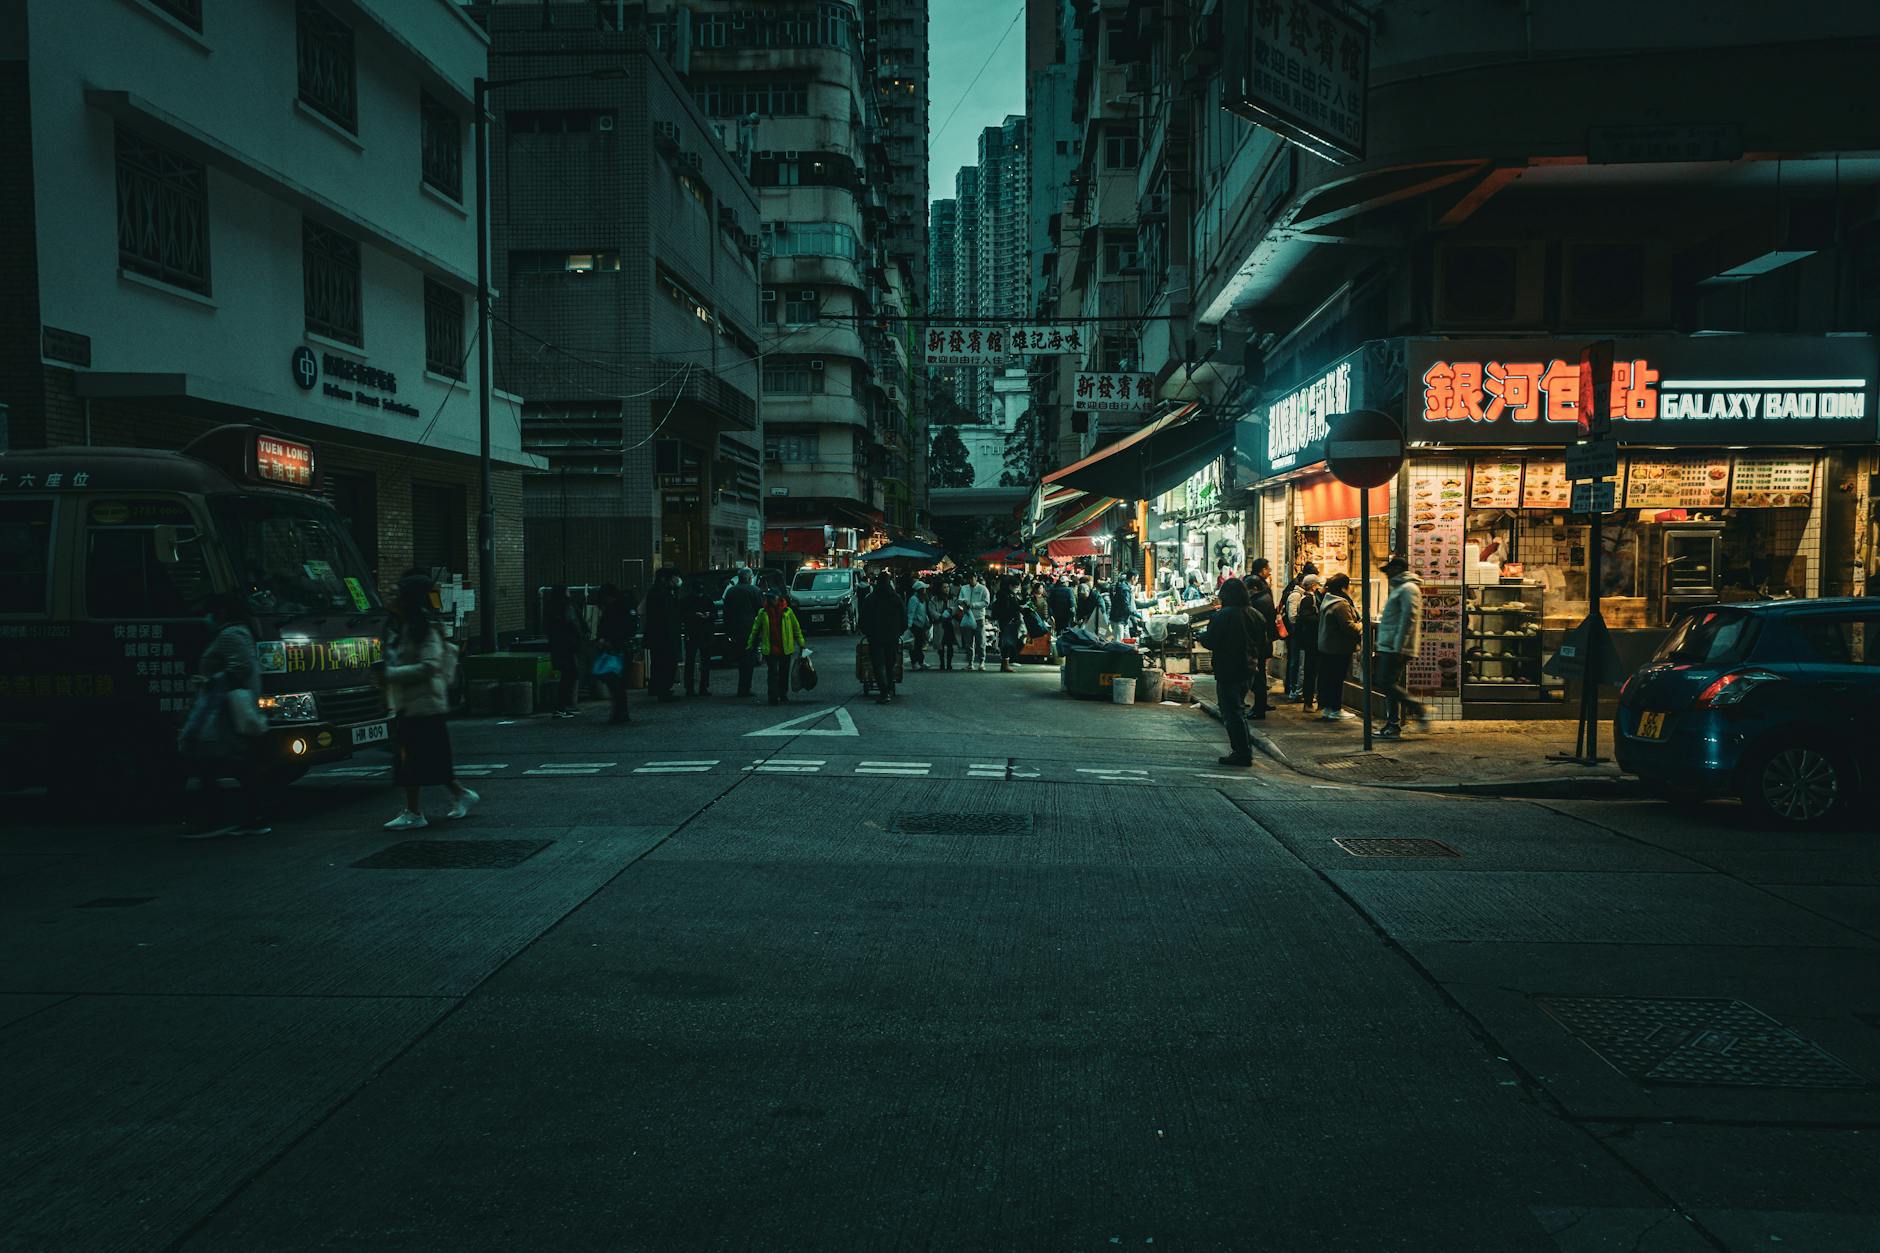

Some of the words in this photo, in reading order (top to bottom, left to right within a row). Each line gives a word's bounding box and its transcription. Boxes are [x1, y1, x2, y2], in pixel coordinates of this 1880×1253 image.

[1255, 37, 1361, 116] 歡迎自由行人住
[927, 329, 1002, 353] 新發賓館
[1011, 329, 1082, 350] 雄記海味
[927, 356, 1003, 365] 歡迎自由行人住
[1076, 375, 1153, 399] 新發賓館
[356, 391, 379, 407] Street
[1660, 393, 1761, 419] GALAXY
[1763, 393, 1816, 419] BAO
[1819, 393, 1865, 418] DIM
[259, 440, 283, 456] YUEN
[286, 446, 309, 462] LONG
[258, 458, 310, 485] 元朗屯門
[368, 726, 383, 738] 809
